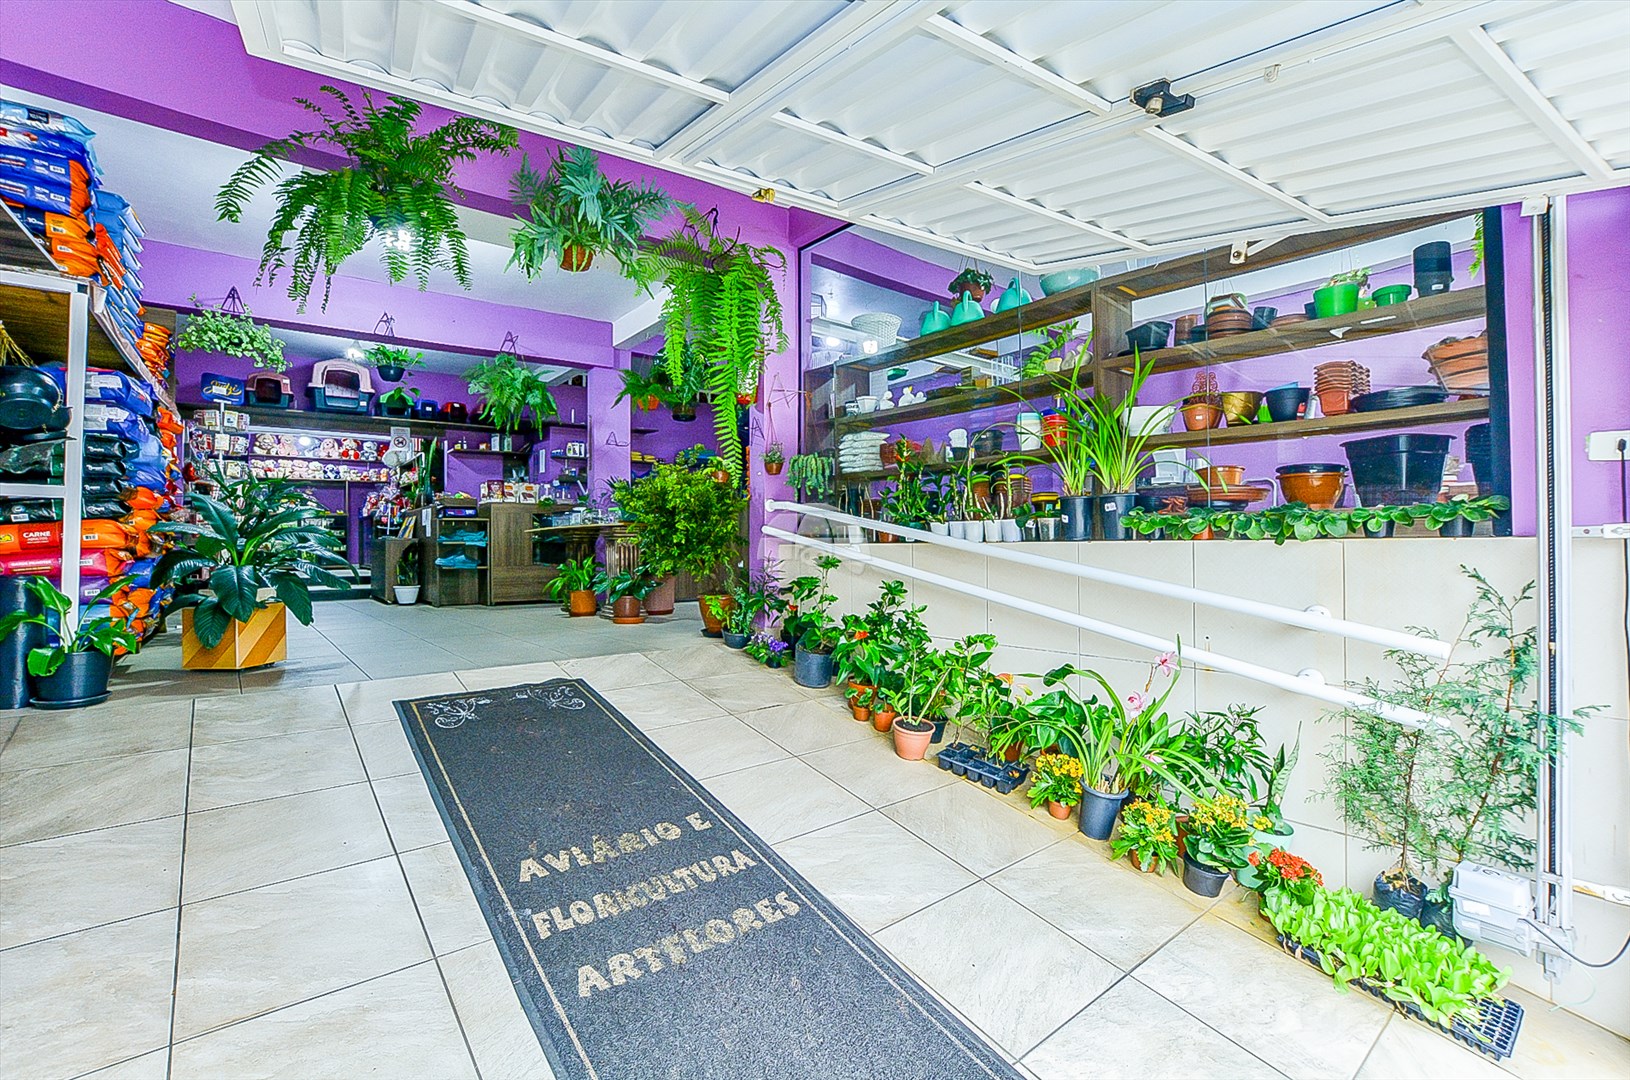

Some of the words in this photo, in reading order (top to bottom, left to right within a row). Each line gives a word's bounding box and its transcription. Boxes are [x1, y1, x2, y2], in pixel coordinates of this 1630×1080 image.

[23, 530, 51, 538] CARNE
[685, 811, 713, 831] E
[531, 849, 758, 940] FLORICULTURA
[577, 891, 800, 998] ARTFLORES
